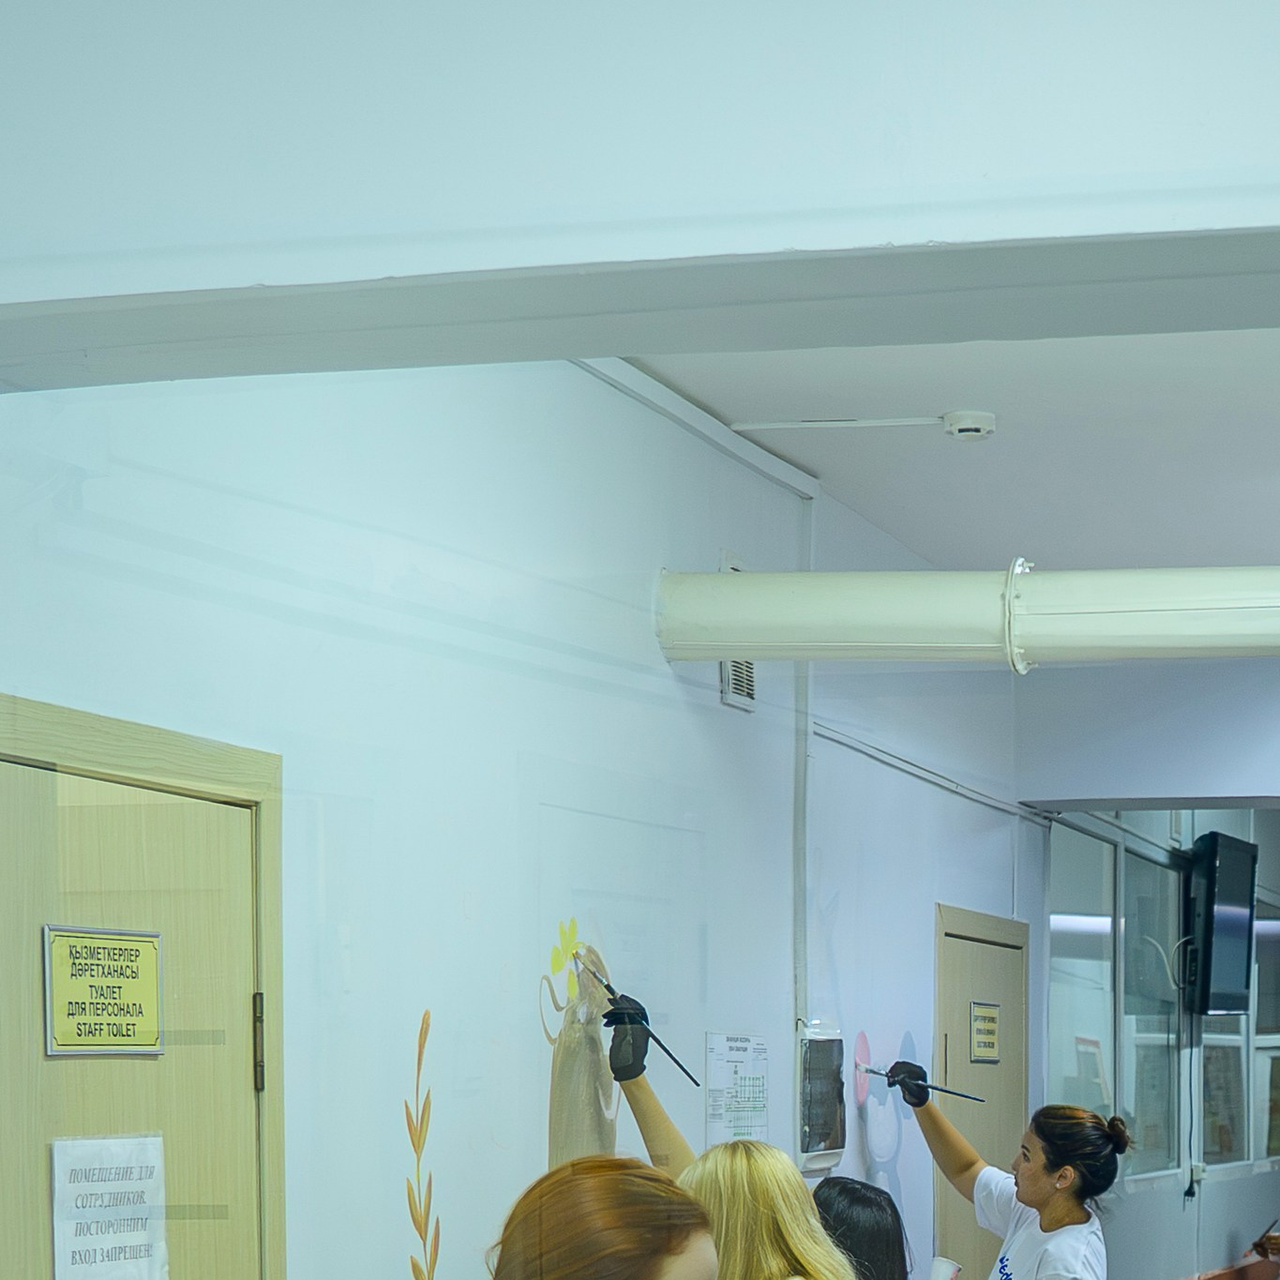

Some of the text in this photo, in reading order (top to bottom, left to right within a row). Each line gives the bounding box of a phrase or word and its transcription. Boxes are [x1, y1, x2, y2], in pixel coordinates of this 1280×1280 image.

[69, 945, 141, 962] ҚЫЗМЕТКЕРЛЕР
[70, 963, 139, 979] ДӘРЕТХАНАСЫ
[89, 985, 122, 1000] ТУАЛЕТ
[67, 1001, 144, 1019] ДЛЯ ПЕРСОНАЛА
[76, 1022, 137, 1037] STAFF TOILET
[68, 1165, 156, 1184] ПОМЕЩЕНИЕ ДЛЯ
[74, 1217, 149, 1237] ПОСТОРОННИМ
[70, 1248, 98, 1266] ВХОД
